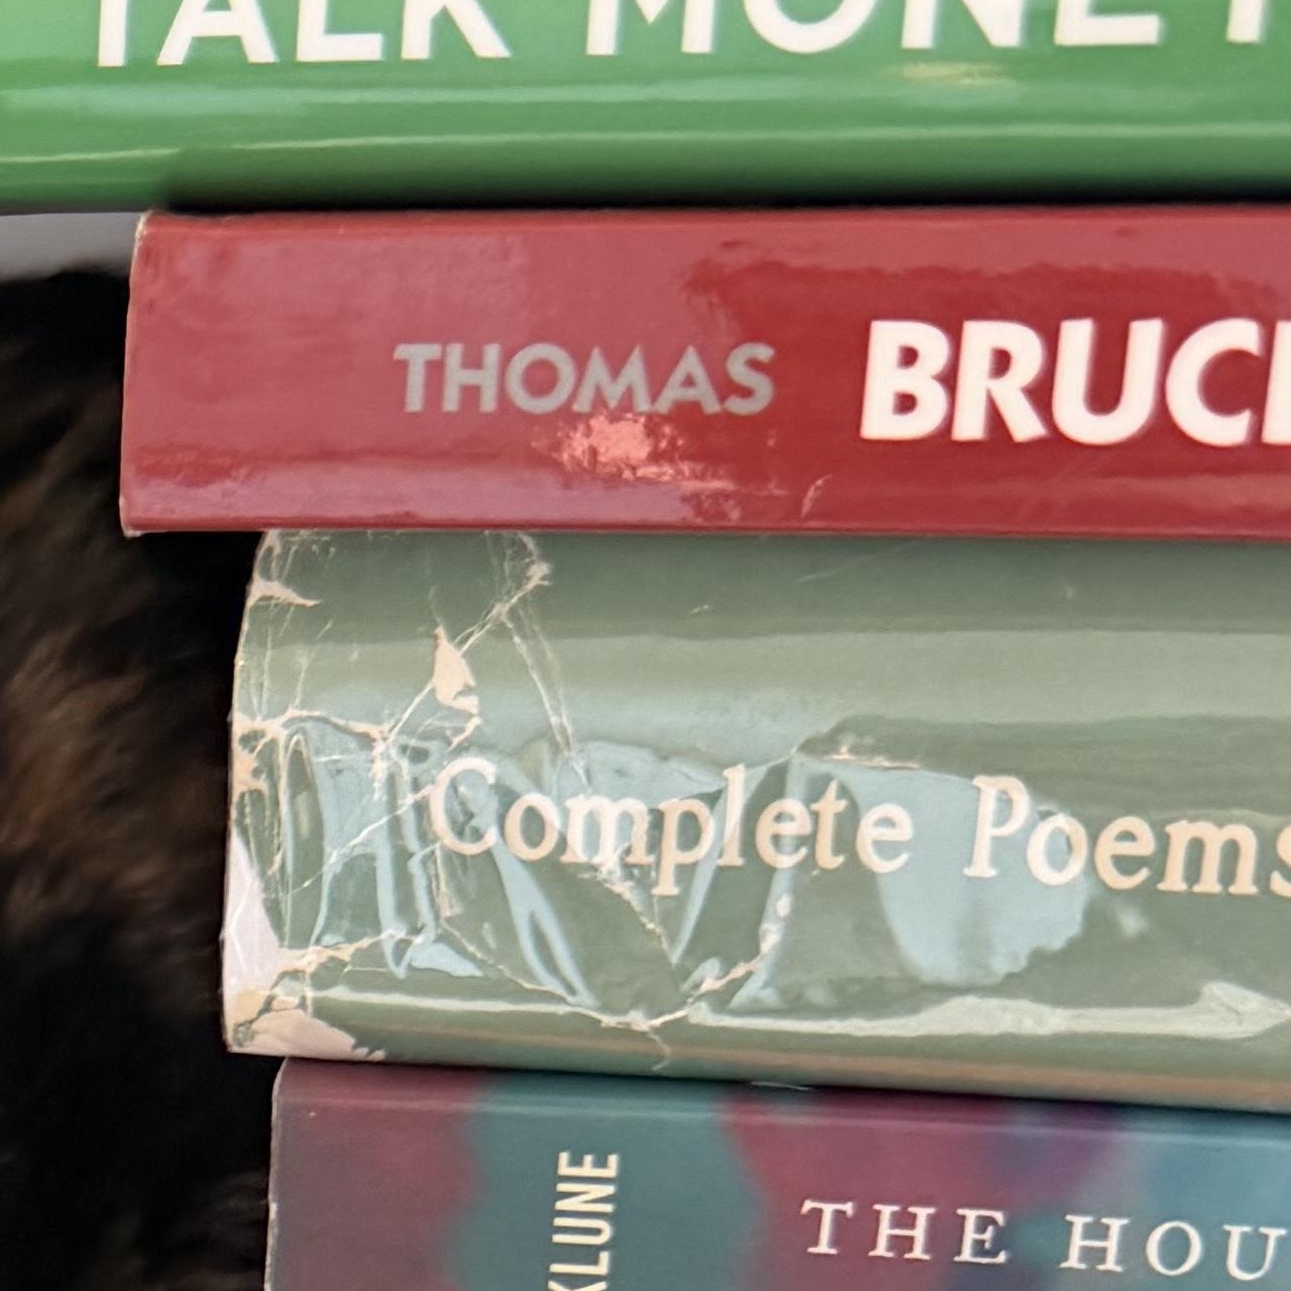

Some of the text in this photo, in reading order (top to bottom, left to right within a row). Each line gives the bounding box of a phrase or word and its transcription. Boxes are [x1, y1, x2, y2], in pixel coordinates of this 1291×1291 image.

[394, 317, 1291, 447] THOMAS BRUC
[430, 759, 913, 895] Complete
[801, 1198, 1286, 1282] THE HOU
